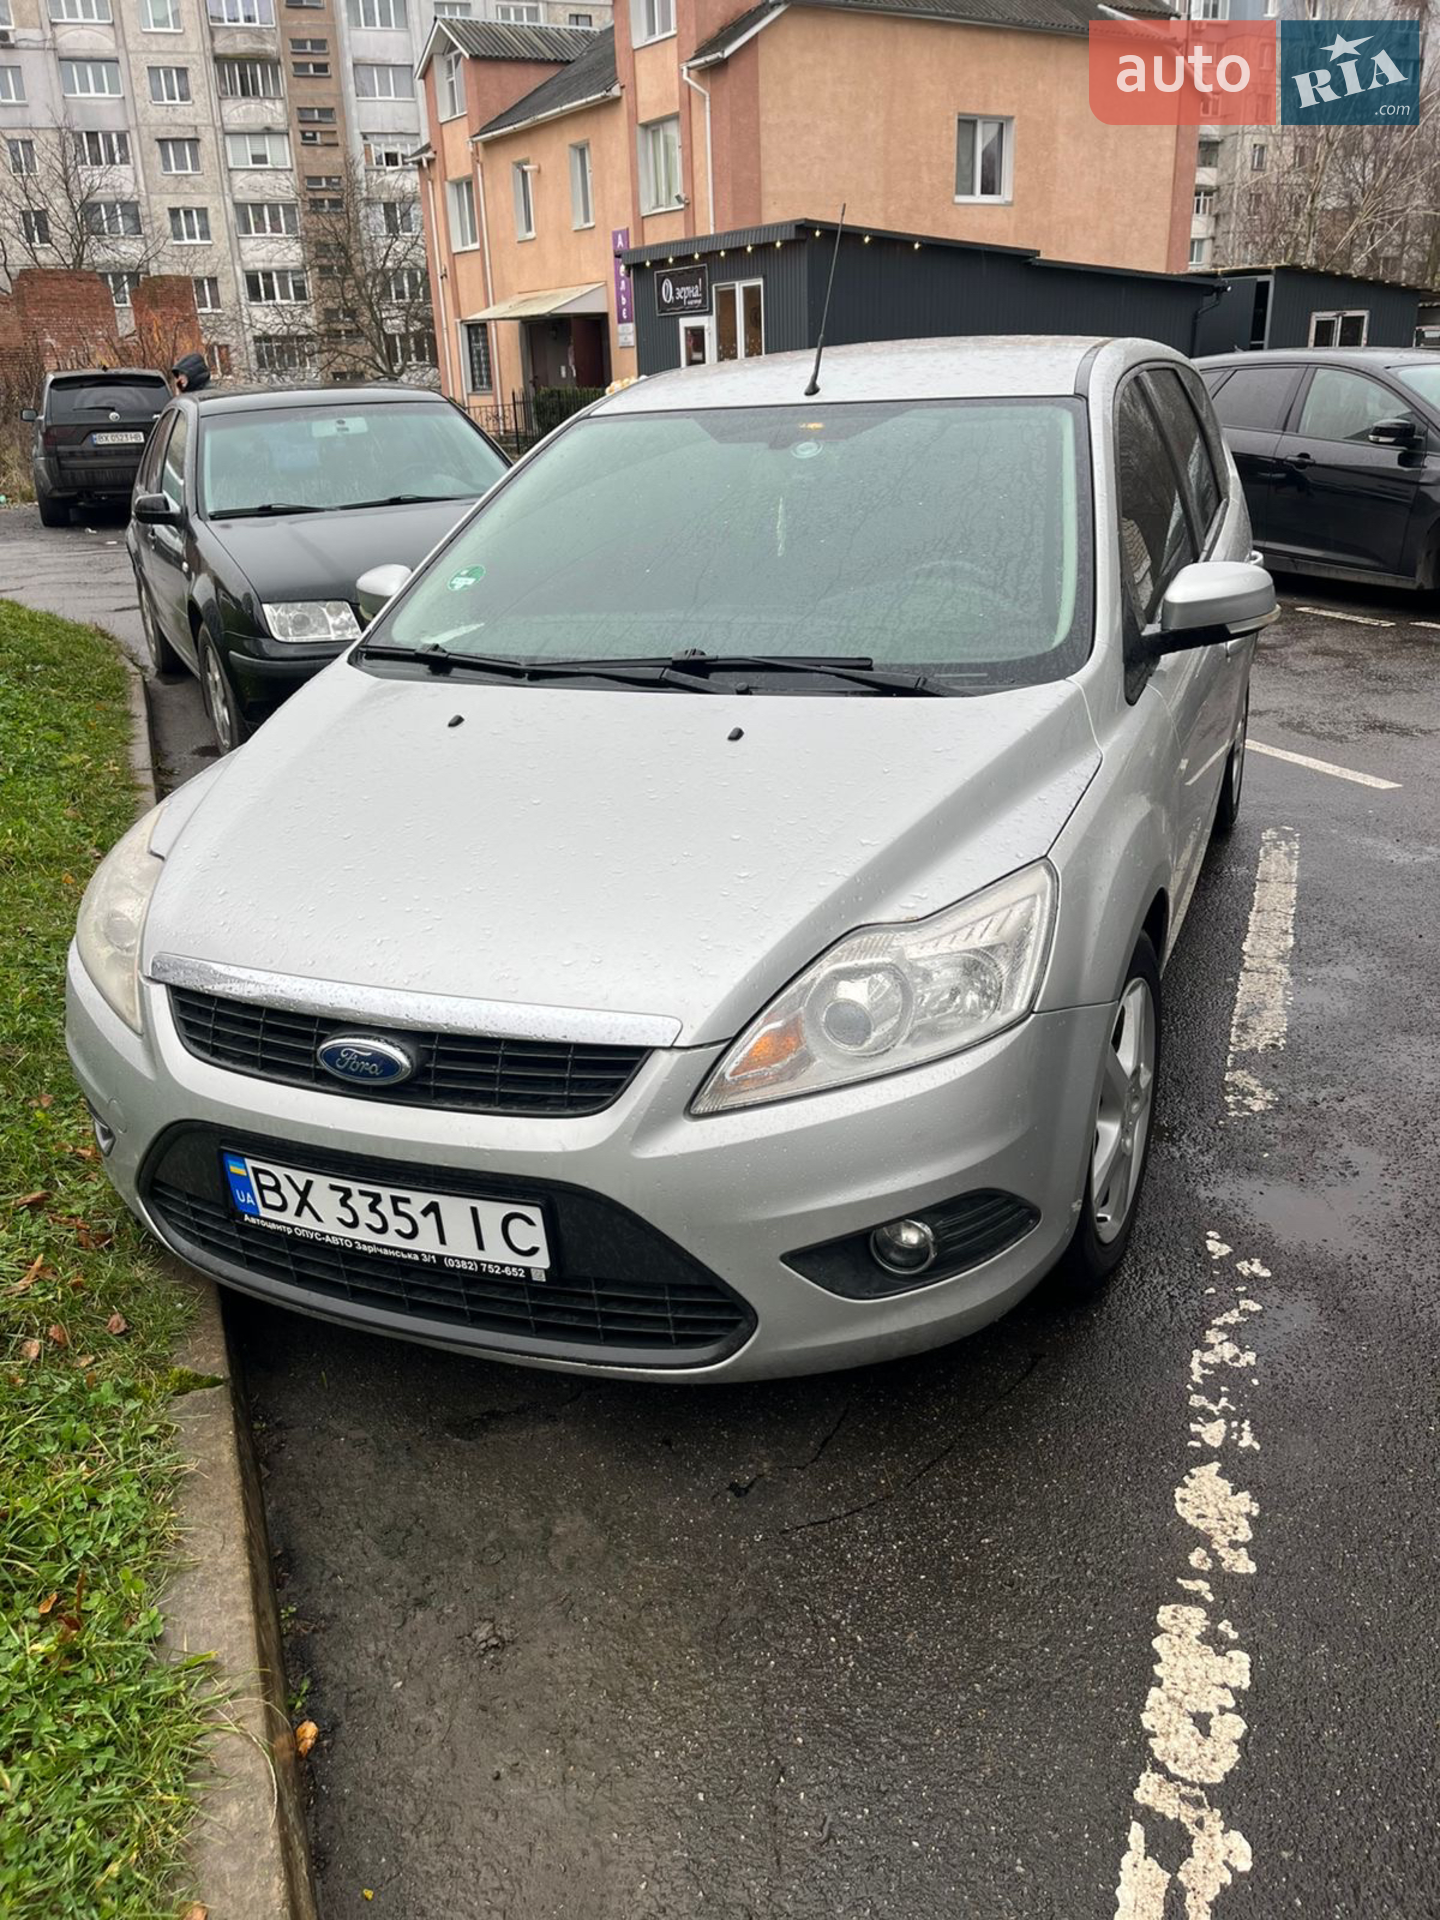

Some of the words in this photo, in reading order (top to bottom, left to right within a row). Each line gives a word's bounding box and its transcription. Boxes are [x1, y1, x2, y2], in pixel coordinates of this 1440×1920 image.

[616, 233, 628, 319] Аельє
[675, 278, 702, 306] зерна!
[336, 1047, 384, 1076] Ford
[236, 1189, 256, 1206] UA
[251, 1166, 324, 1224] BX
[328, 1183, 447, 1247] 3351
[243, 1214, 293, 1235] Автоцентр
[294, 1227, 353, 1248] ОПУС-АВТО
[354, 1241, 419, 1262] Зарічанська
[421, 1253, 437, 1264] 3/1
[443, 1256, 478, 1272] (0382)
[480, 1262, 526, 1278] 752-652
